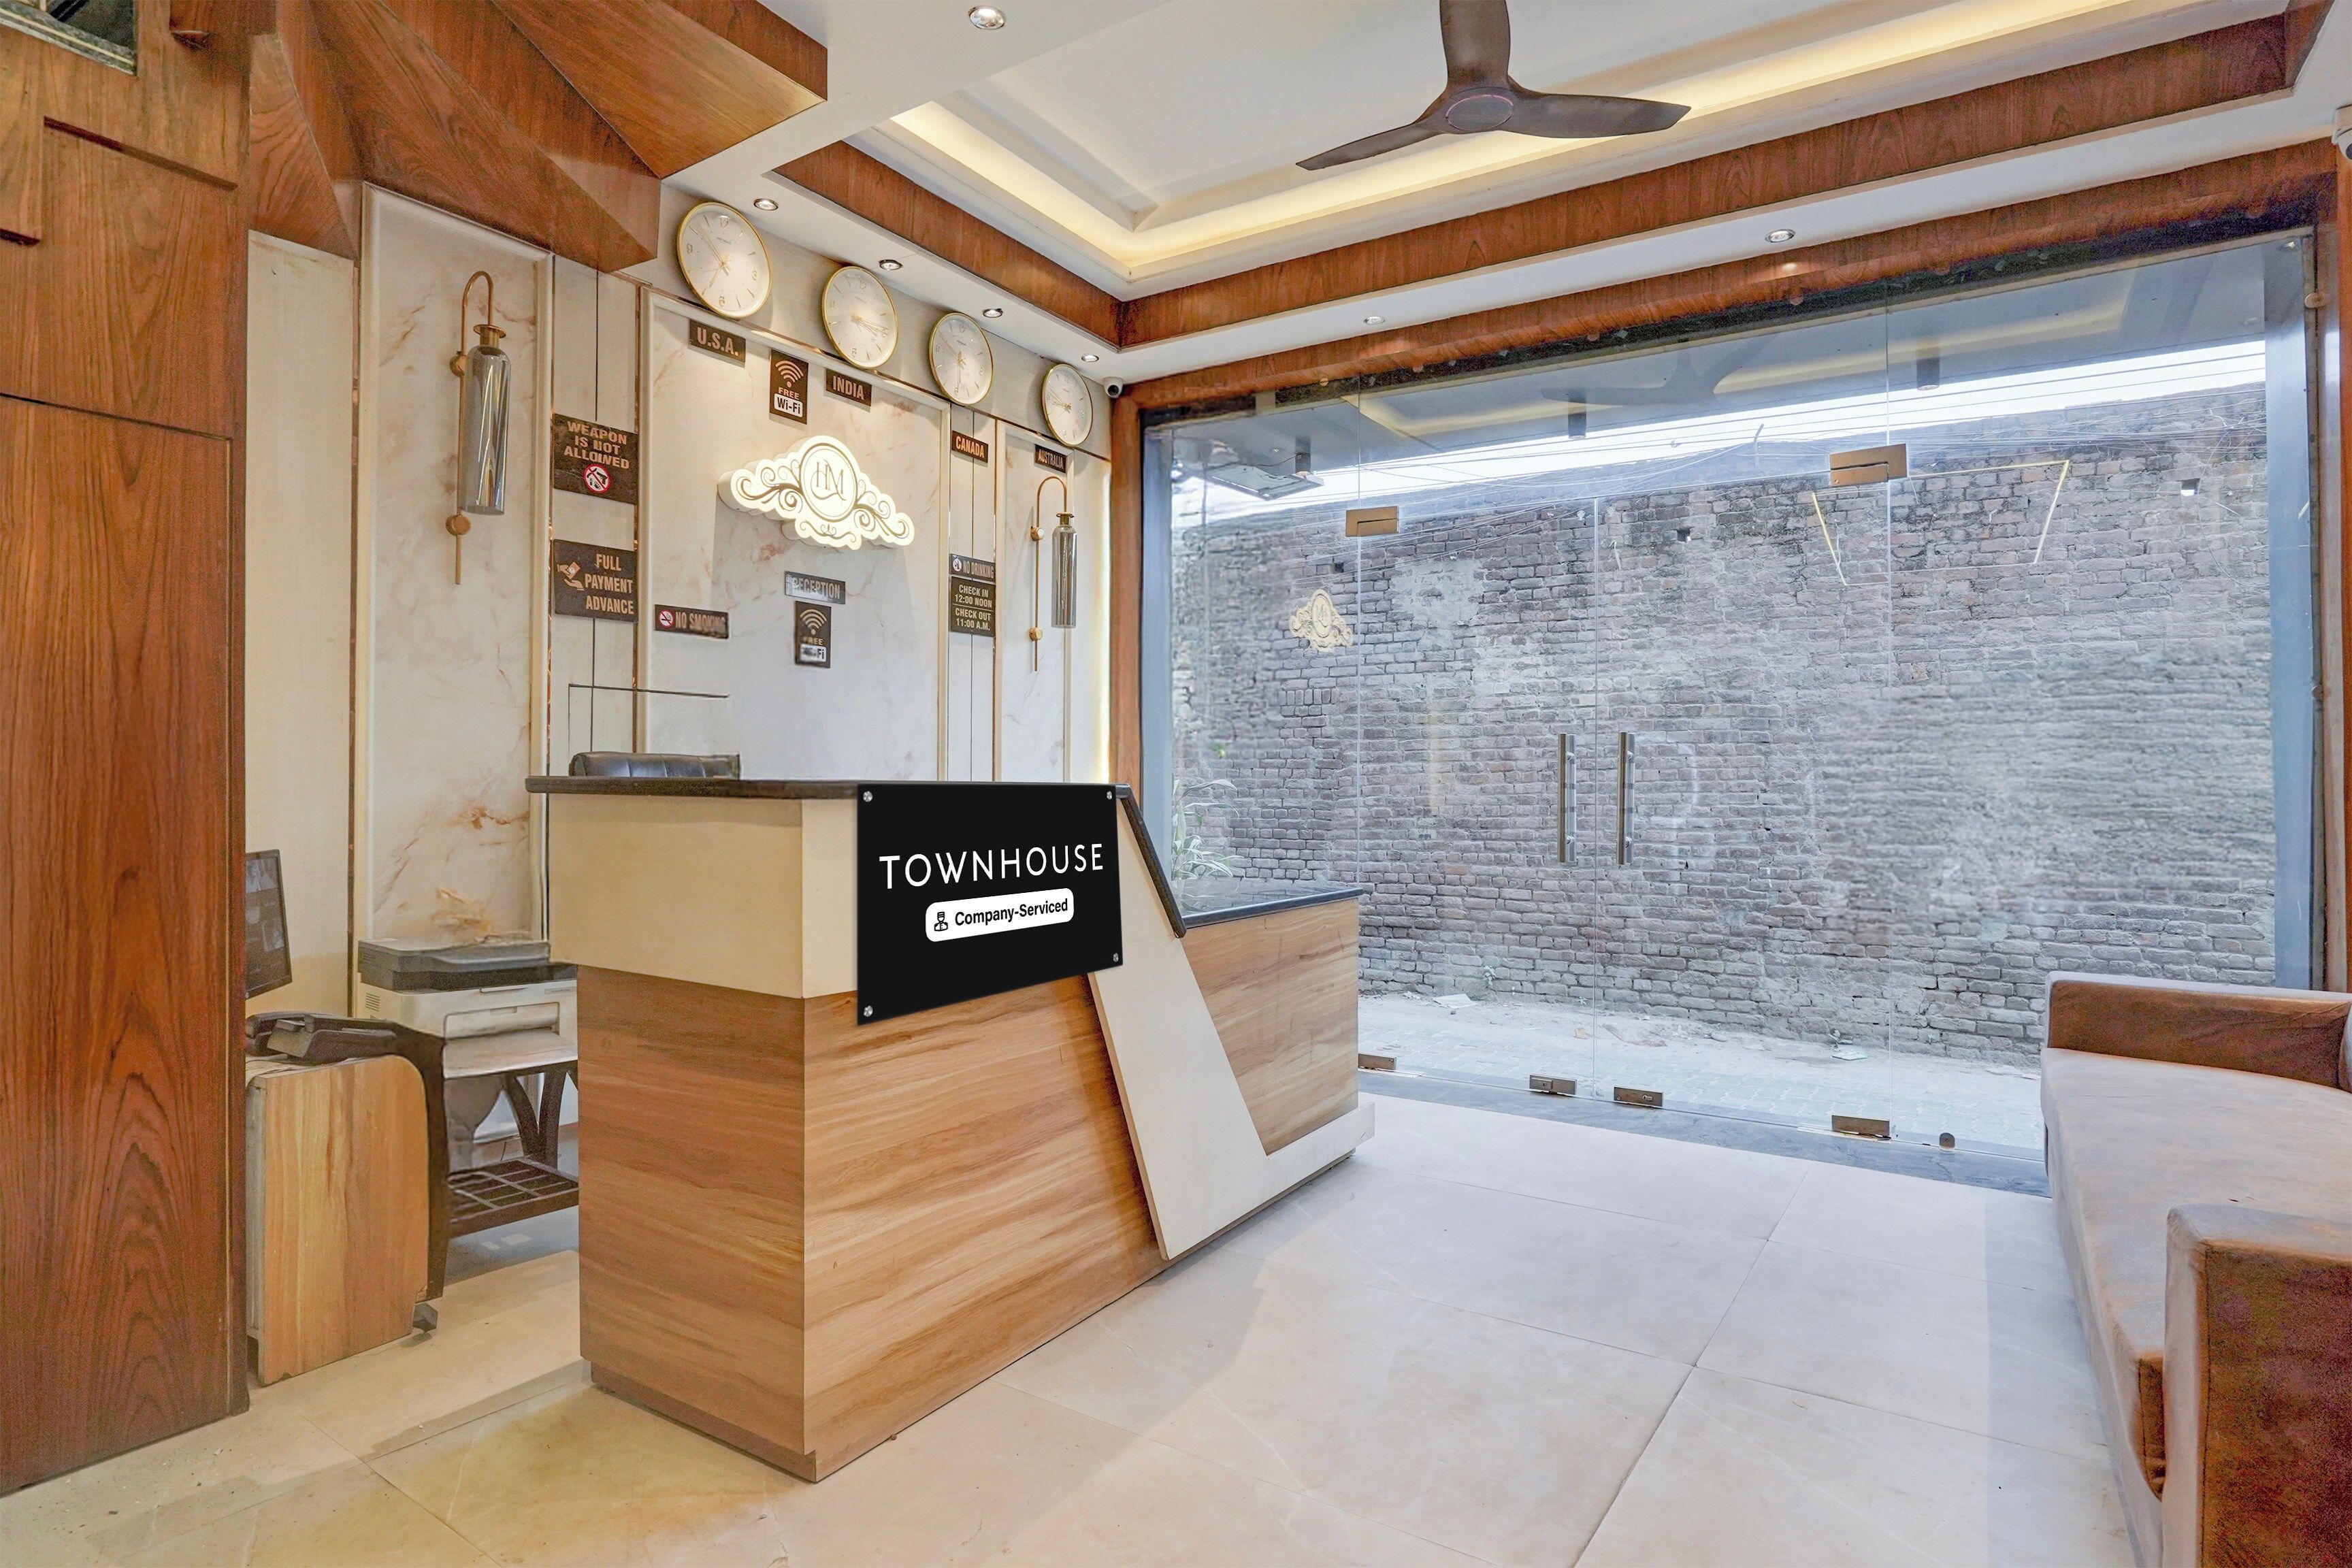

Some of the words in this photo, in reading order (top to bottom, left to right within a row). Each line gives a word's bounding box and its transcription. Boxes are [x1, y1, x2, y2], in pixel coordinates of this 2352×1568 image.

[697, 326, 739, 357] U.S.A.
[778, 387, 800, 400] FREE
[832, 375, 865, 400] INDIA
[777, 396, 801, 414] Wi-Fi
[567, 421, 627, 445] WEAPON
[574, 435, 589, 448] IS
[956, 436, 985, 459] CANADA
[564, 445, 630, 470] ALLOWED
[1037, 449, 1064, 470] AUSTRALIA
[595, 553, 622, 571] FULL
[963, 560, 970, 574] NO
[971, 561, 994, 579] DRINKING
[584, 573, 634, 594] PAYMENT
[958, 585, 981, 597] CHECK
[982, 589, 989, 598] IN
[585, 595, 634, 615] ADVANCE
[955, 593, 973, 606] 12:00
[975, 598, 992, 608] NOON
[675, 611, 687, 630] NO
[955, 607, 977, 620] CHECK
[978, 611, 992, 622] OUT
[956, 617, 975, 629] 11:00
[976, 621, 990, 631] A.M.
[879, 843, 1103, 889] TOWNHOUSE
[955, 898, 1068, 926] Company-Serviced
